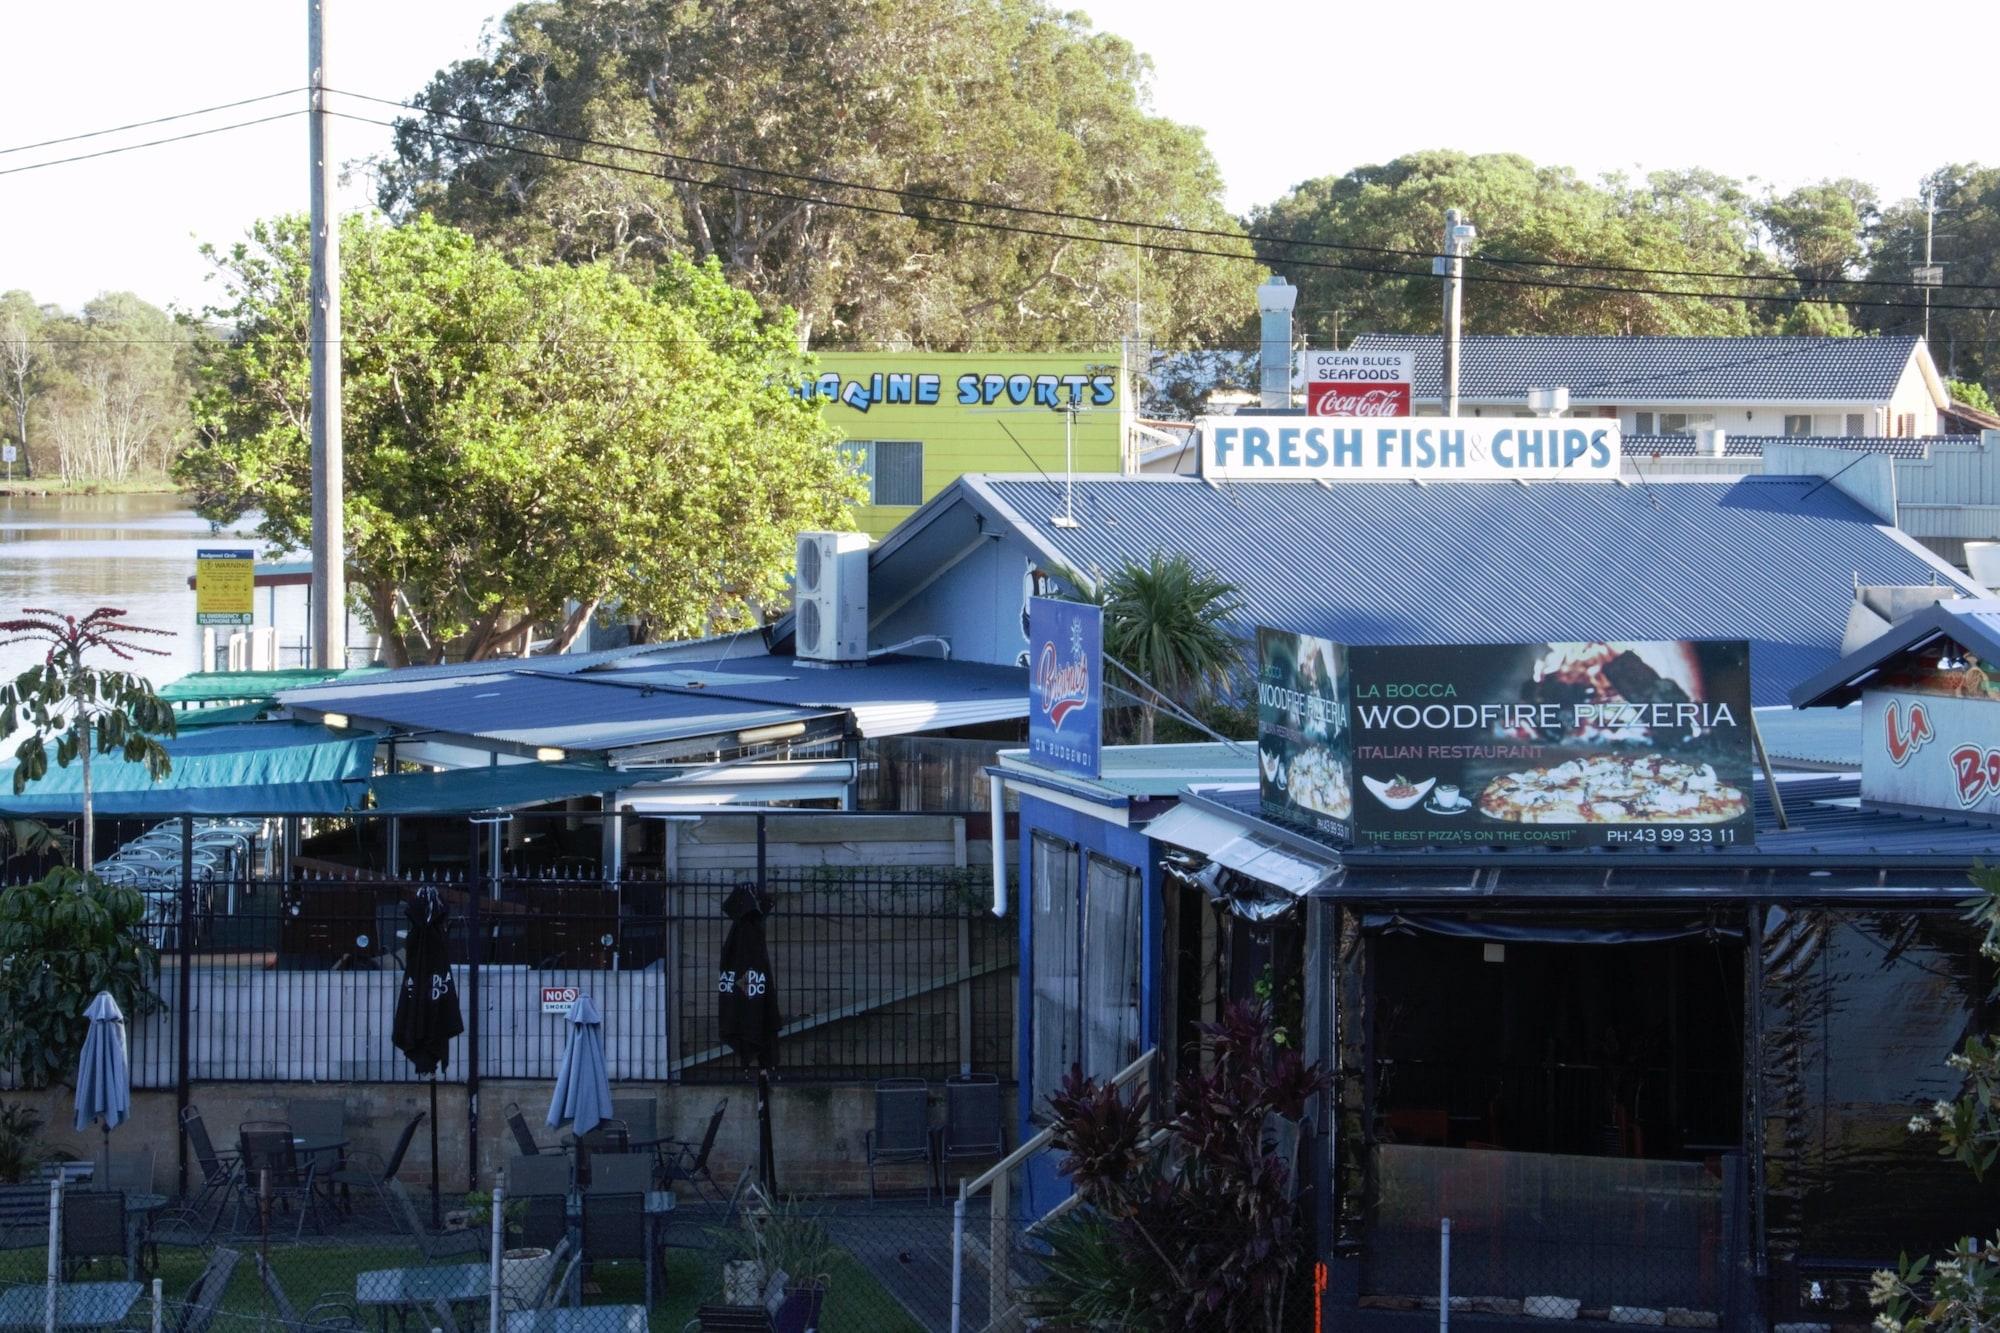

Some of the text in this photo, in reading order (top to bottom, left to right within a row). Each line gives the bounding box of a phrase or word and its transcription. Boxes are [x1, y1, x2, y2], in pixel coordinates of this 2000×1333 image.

[1317, 356, 1402, 366] OCEAN BLUES
[1318, 368, 1400, 380] SEAFOODS
[788, 372, 1116, 414] ARINE SPORTS
[1214, 426, 1612, 469] FRESH FISH & CHIPS
[1356, 683, 1458, 698] LA BOCCA
[1258, 683, 1305, 716] WOODFIRE
[1357, 702, 1737, 730] WOODFIRE PIZZERIA
[1358, 744, 1546, 759] ITALIAN RESTAURANT
[1393, 831, 1426, 841] BEST
[1427, 830, 1472, 841] PIZZA'S
[1474, 831, 1494, 841] ON
[1496, 831, 1521, 841] THE
[1660, 829, 1685, 842] 99
[1689, 829, 1713, 842] 33
[1719, 829, 1735, 842] 11
[546, 990, 562, 1001] NO
[545, 1003, 572, 1011] SMOKIN
